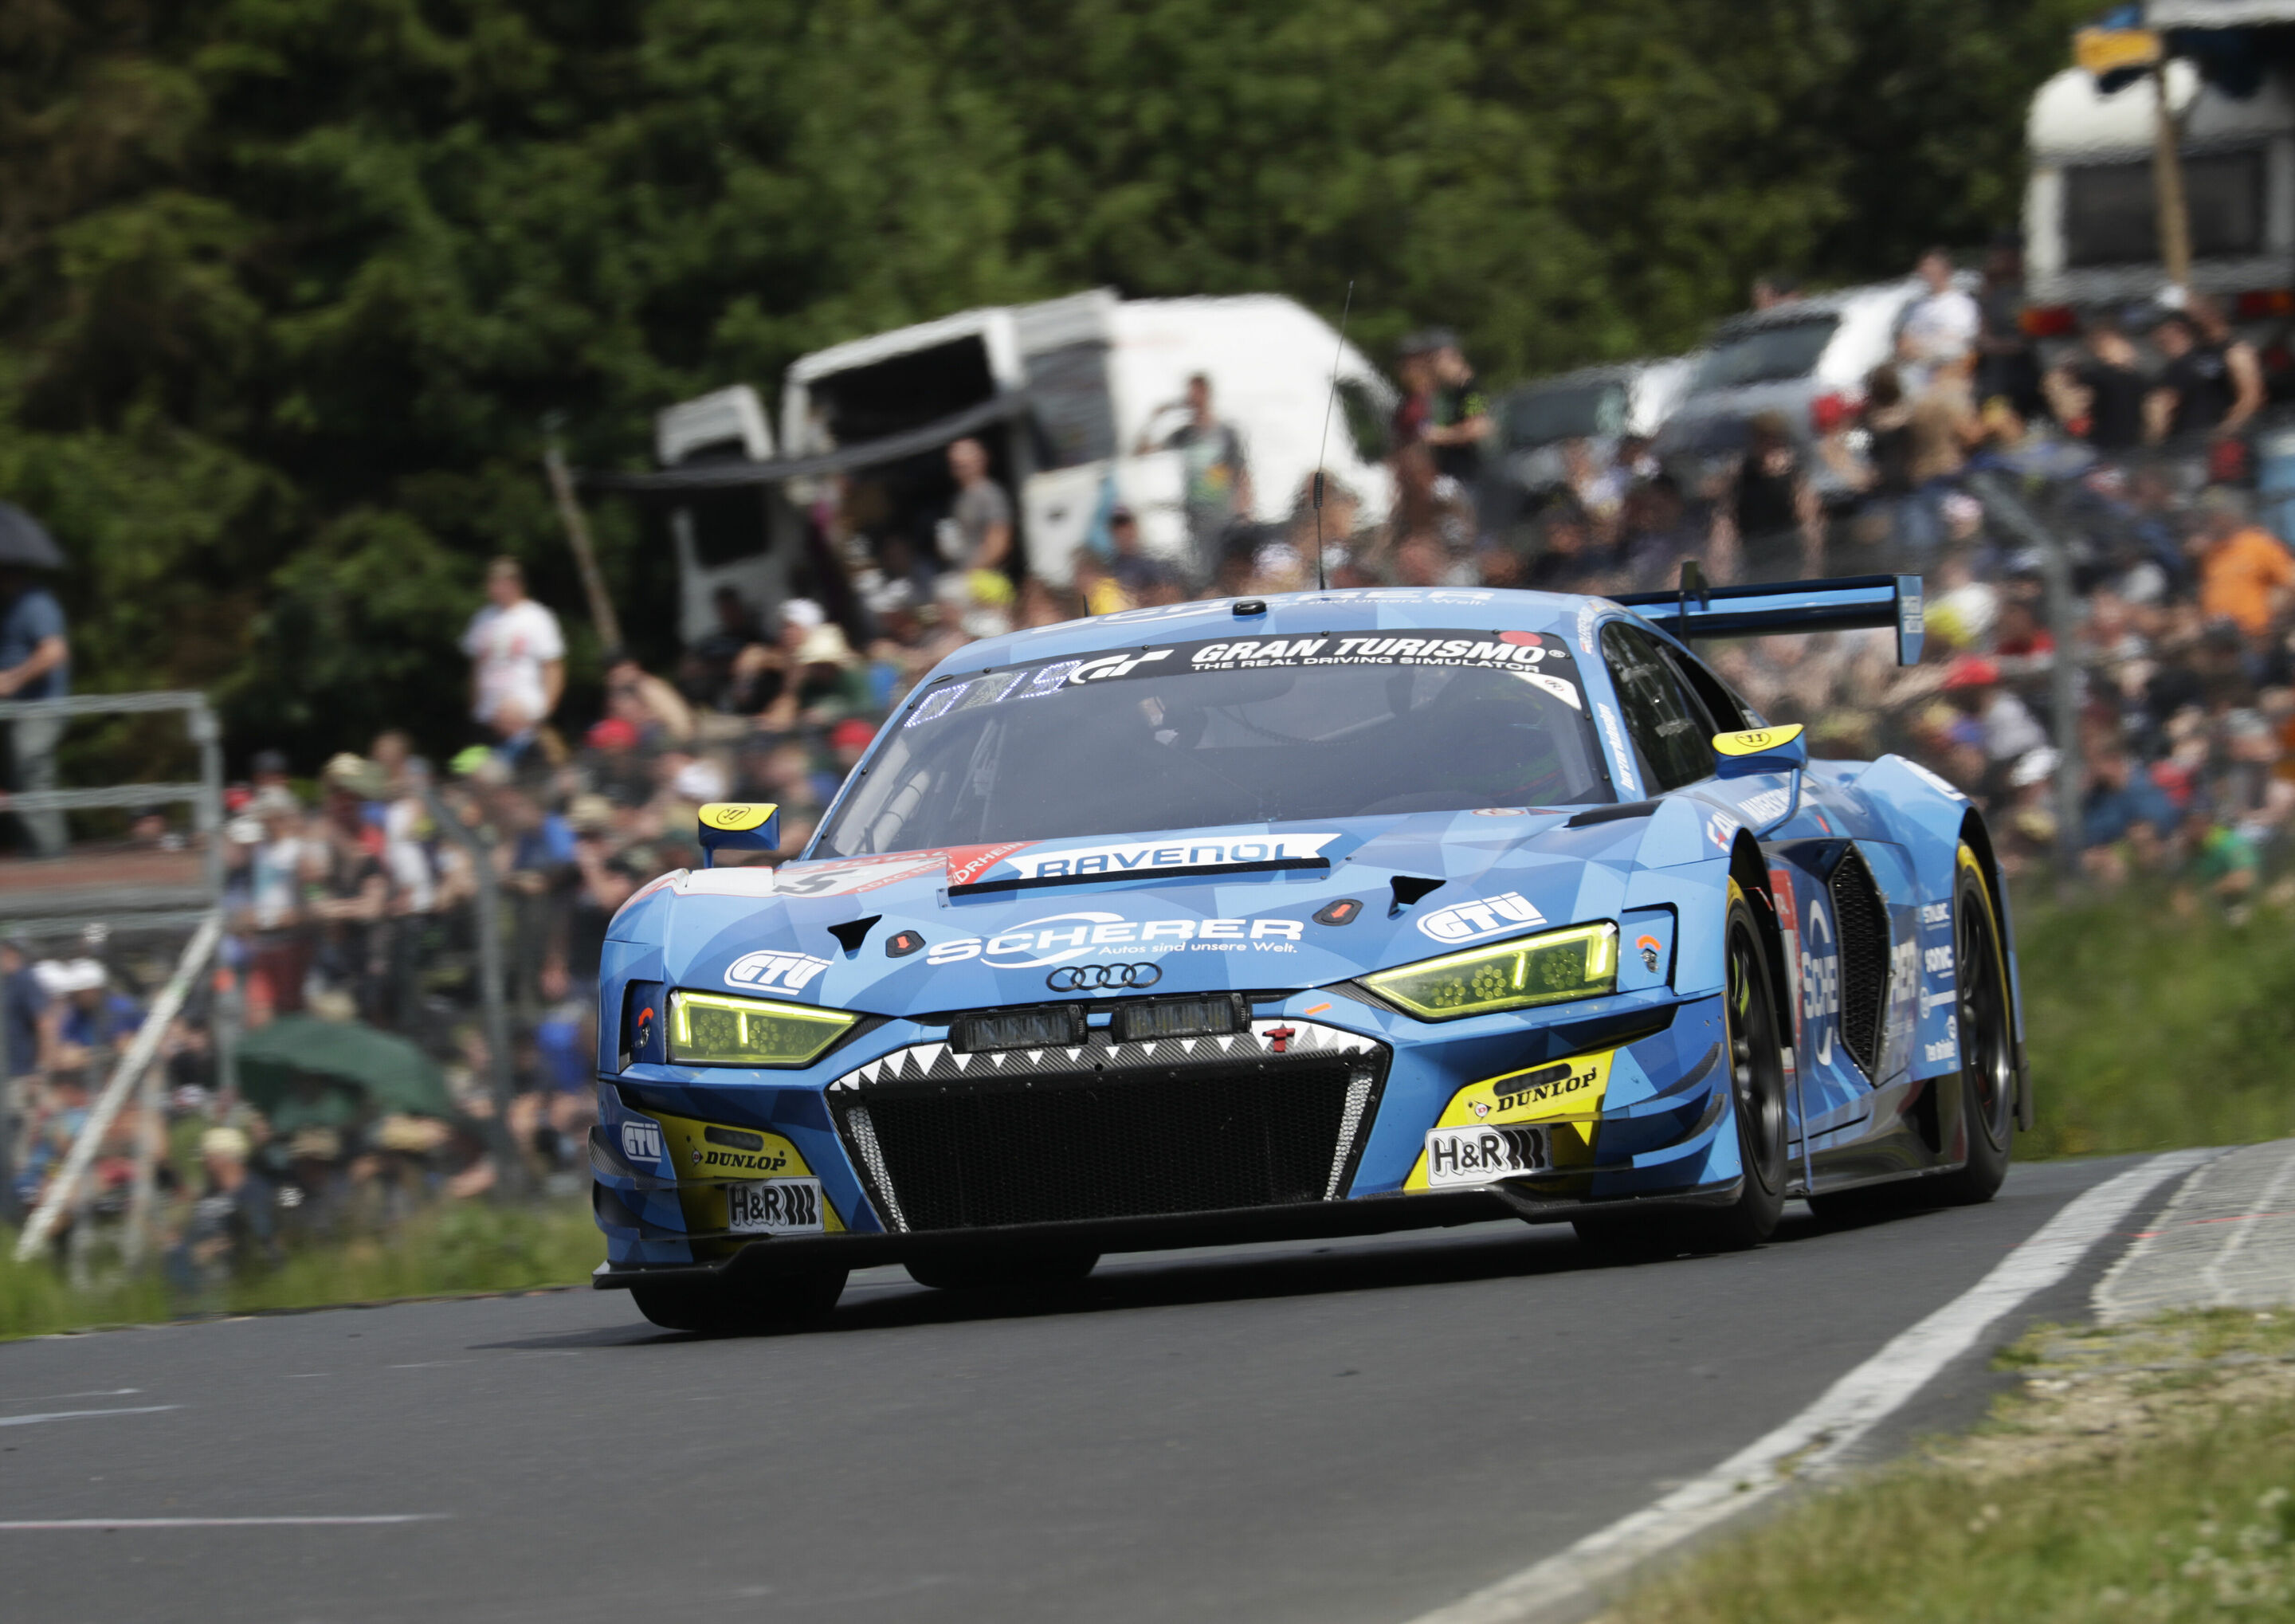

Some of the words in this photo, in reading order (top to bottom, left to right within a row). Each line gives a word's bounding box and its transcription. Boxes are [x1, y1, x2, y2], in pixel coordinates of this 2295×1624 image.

[1191, 639, 1329, 663] GRAN
[1334, 638, 1547, 664] TURISMO
[1191, 662, 1234, 671] THE
[1241, 659, 1298, 668] REAL
[1304, 656, 1393, 665] DRIVING
[1399, 656, 1540, 673] SIMULATOR
[1036, 843, 1303, 878] RAVENOL
[926, 918, 1305, 965] SCHERER
[1098, 943, 1146, 955] Autos
[1151, 942, 1186, 953] sind
[1191, 942, 1247, 952] unsere
[1253, 941, 1298, 954] Welt.
[1497, 1073, 1597, 1112] DUNLOP
[705, 1151, 787, 1171] DUNLOP
[1434, 1134, 1503, 1173] H&R
[730, 1186, 783, 1222] H&R
